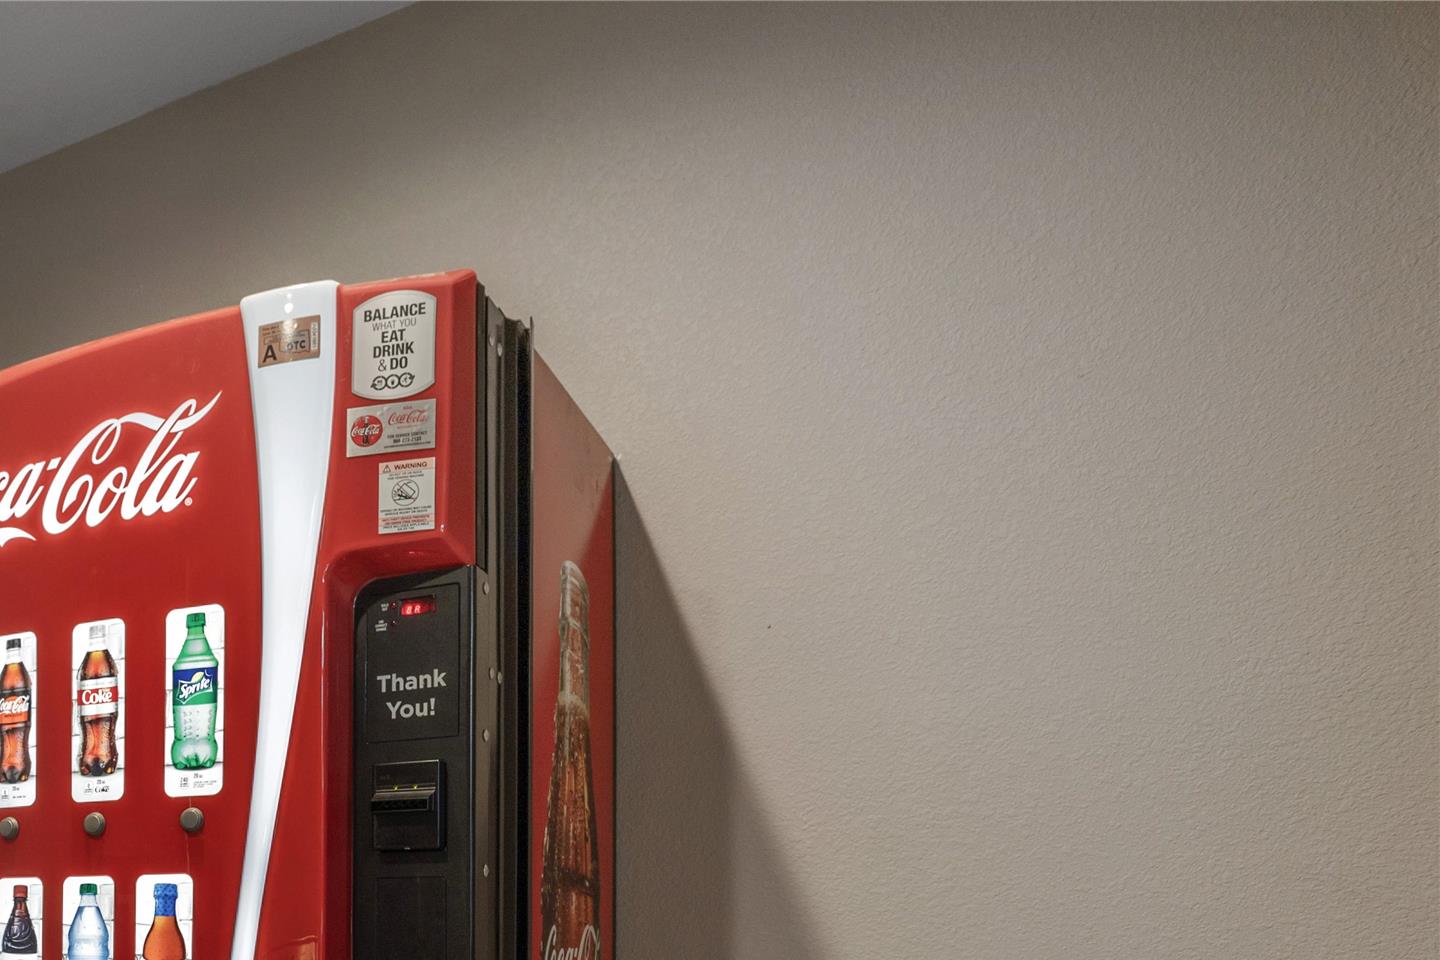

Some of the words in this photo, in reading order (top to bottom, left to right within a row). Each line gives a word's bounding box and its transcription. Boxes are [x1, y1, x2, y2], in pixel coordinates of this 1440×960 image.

[363, 302, 426, 323] BALANCE
[372, 320, 397, 332] WHAT
[400, 317, 417, 328] YOU
[381, 328, 406, 344] EAT
[262, 344, 277, 363] A
[373, 341, 414, 358] DRINK
[377, 358, 387, 372] &
[390, 356, 408, 370] DO
[394, 462, 428, 470] WARNING
[179, 677, 211, 699] Sprite
[376, 668, 447, 693] Thank
[81, 689, 113, 704] Coke
[386, 698, 436, 720] You!
